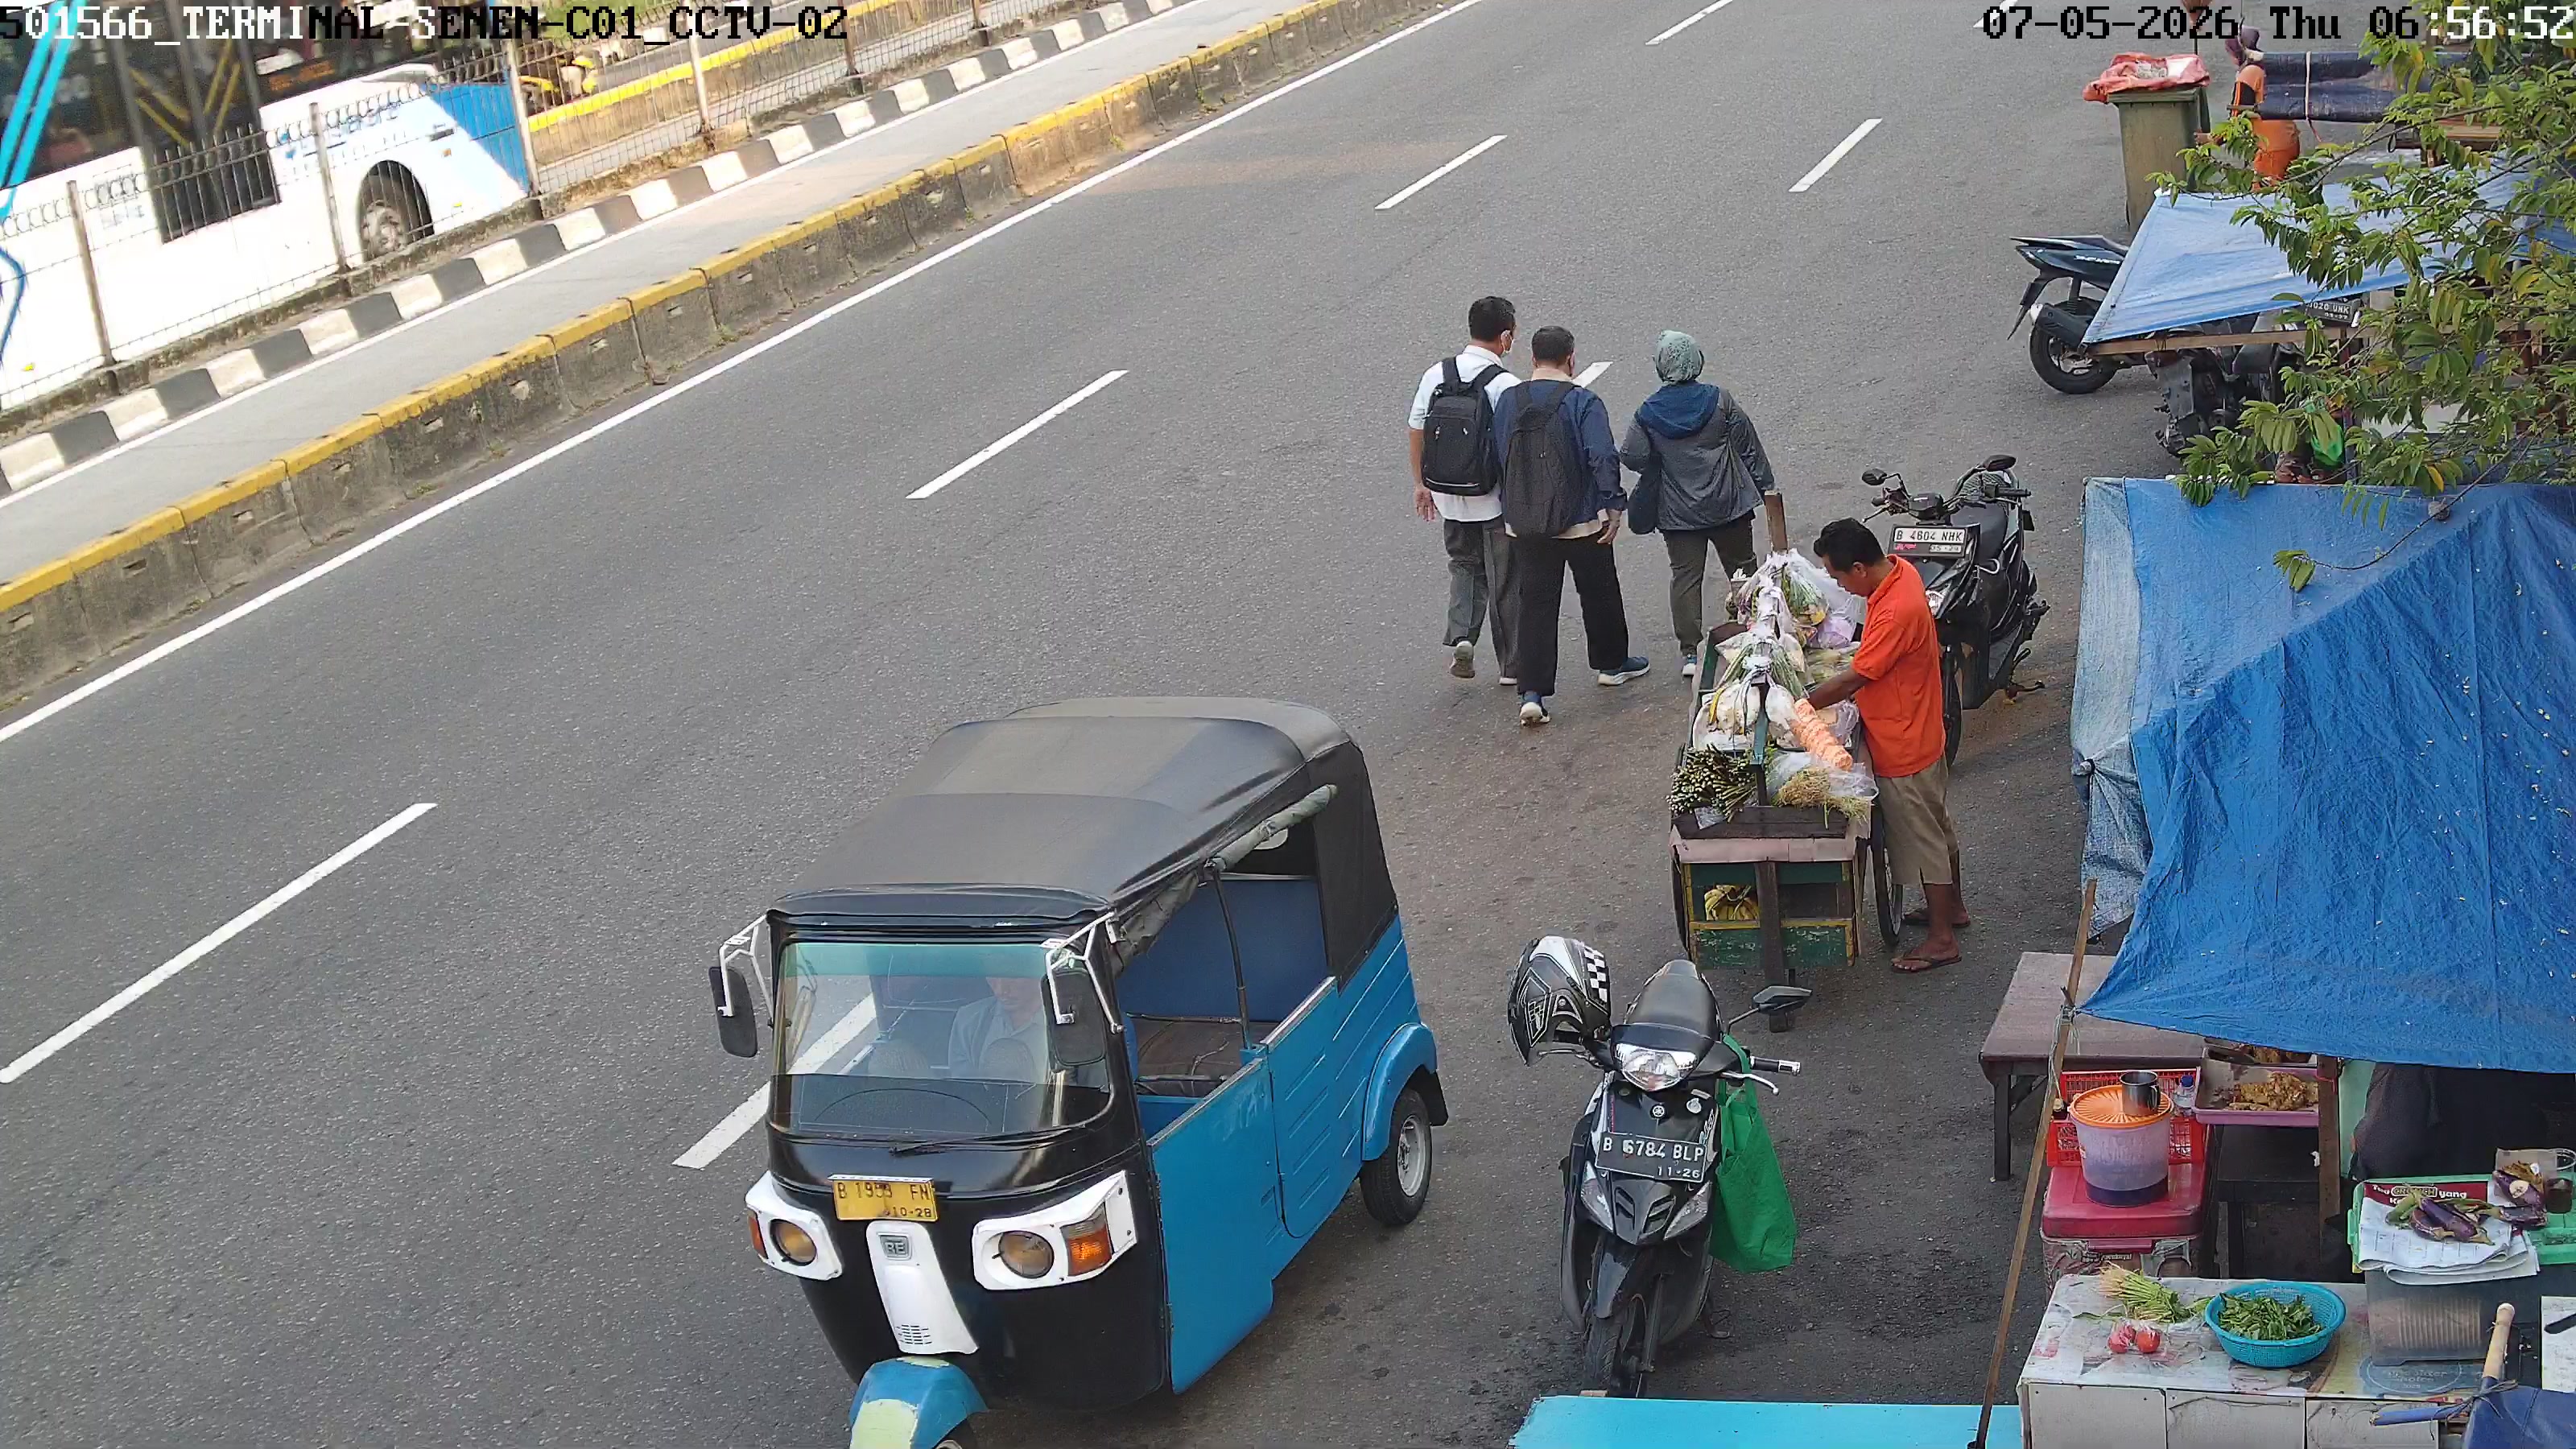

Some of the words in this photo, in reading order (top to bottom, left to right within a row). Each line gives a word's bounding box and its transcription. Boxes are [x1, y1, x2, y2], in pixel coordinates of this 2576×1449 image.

[1896, 530, 1903, 540] B
[1941, 531, 1963, 542] NHK
[1603, 1137, 1612, 1151] B
[1672, 1144, 1704, 1162] BLP
[837, 1182, 847, 1199] B
[2394, 1187, 2435, 1196] CRCH
[2438, 1190, 2467, 1199] yang
[885, 1241, 906, 1254] RE
